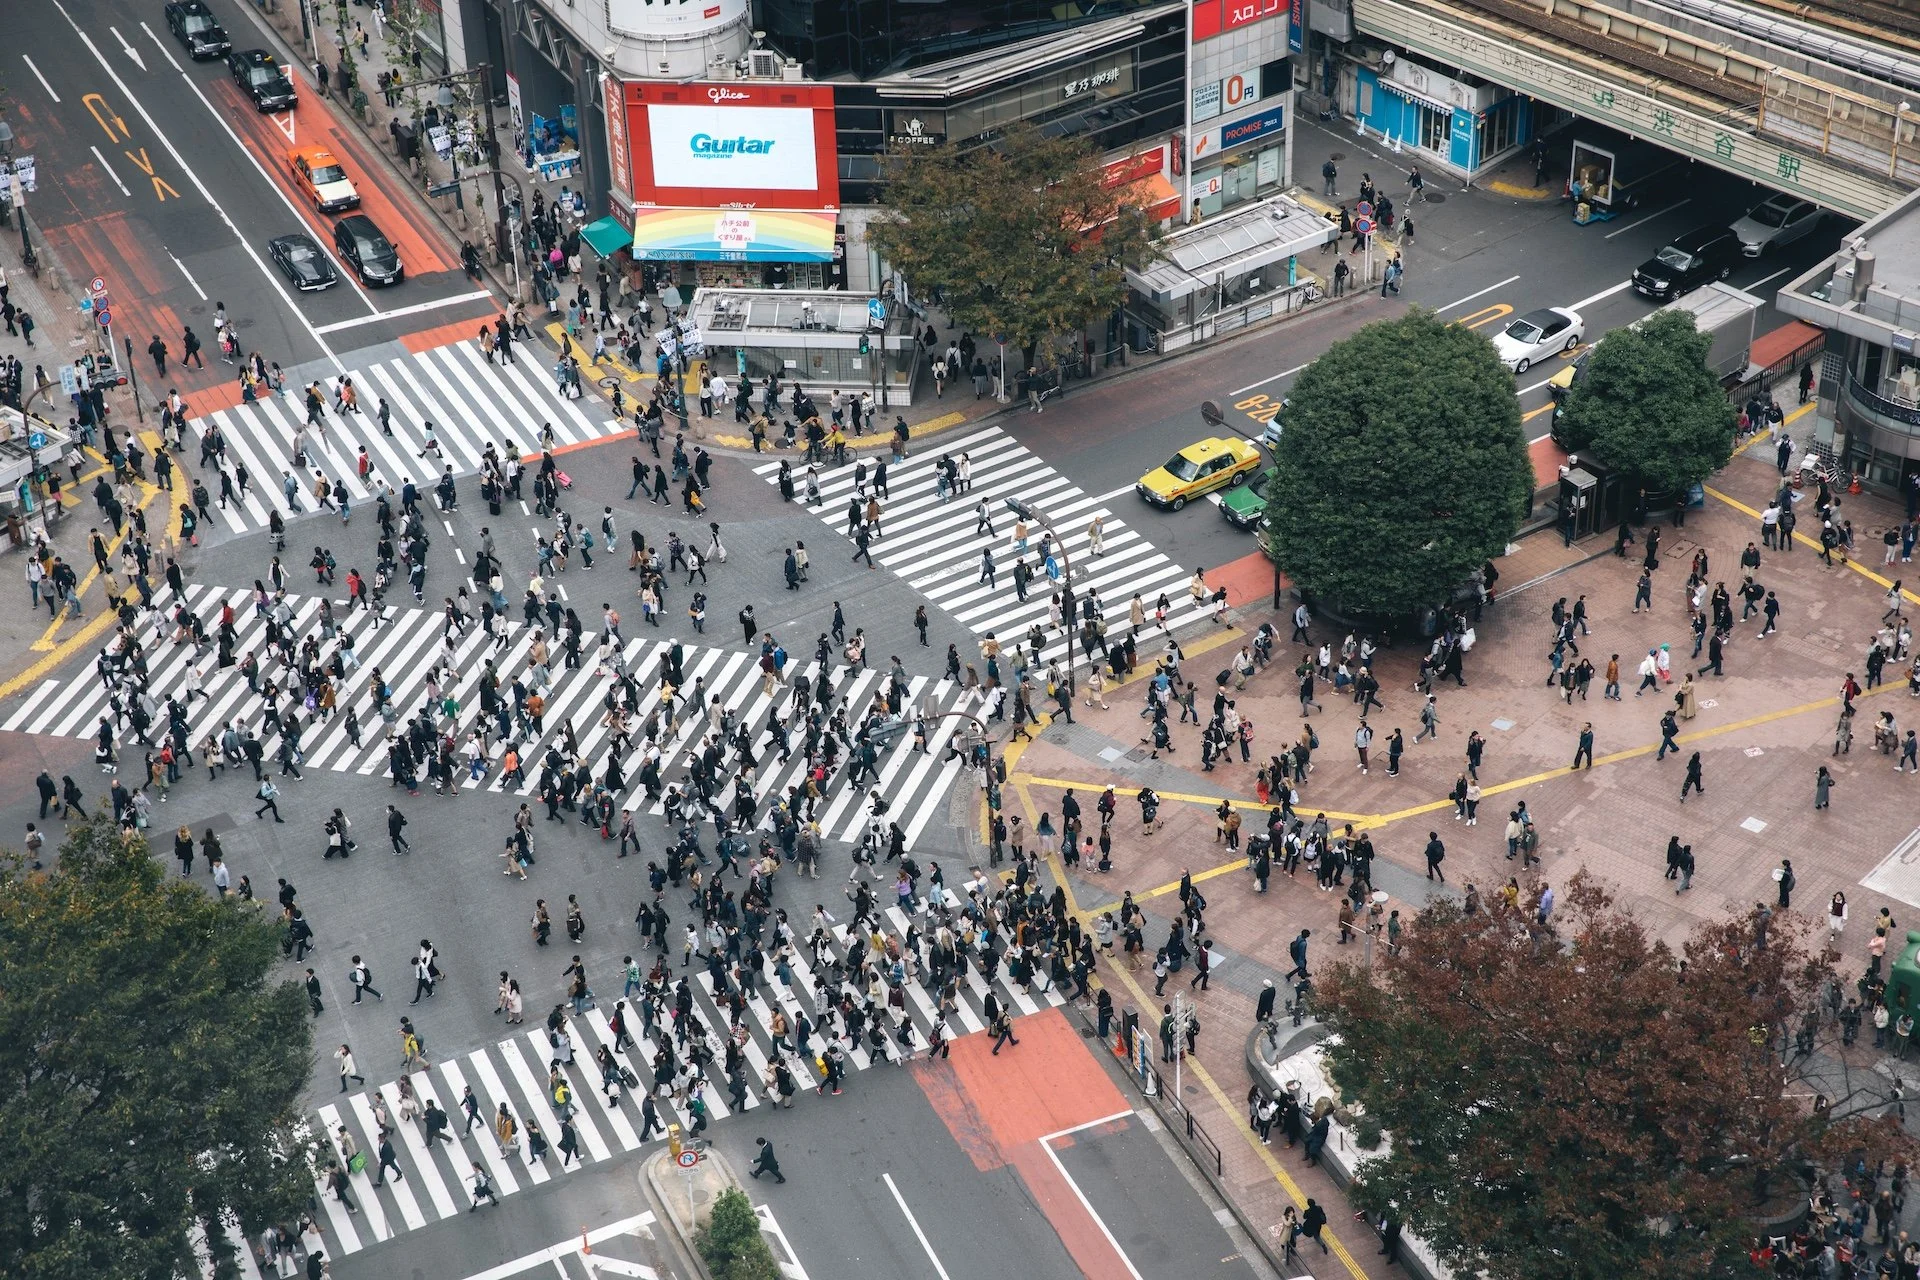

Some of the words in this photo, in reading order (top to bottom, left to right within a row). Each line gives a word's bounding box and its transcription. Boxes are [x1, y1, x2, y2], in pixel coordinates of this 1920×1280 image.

[1231, 5, 1254, 24] 入口
[1064, 66, 1121, 98] 星乃珈琲
[1227, 75, 1254, 105] 0円
[707, 87, 750, 104] Glico
[1592, 90, 1615, 110] JR
[897, 136, 935, 145] COFFEE
[1225, 120, 1263, 141] PROMISE
[690, 133, 776, 154] Guitar
[720, 219, 750, 228] ハチ公前
